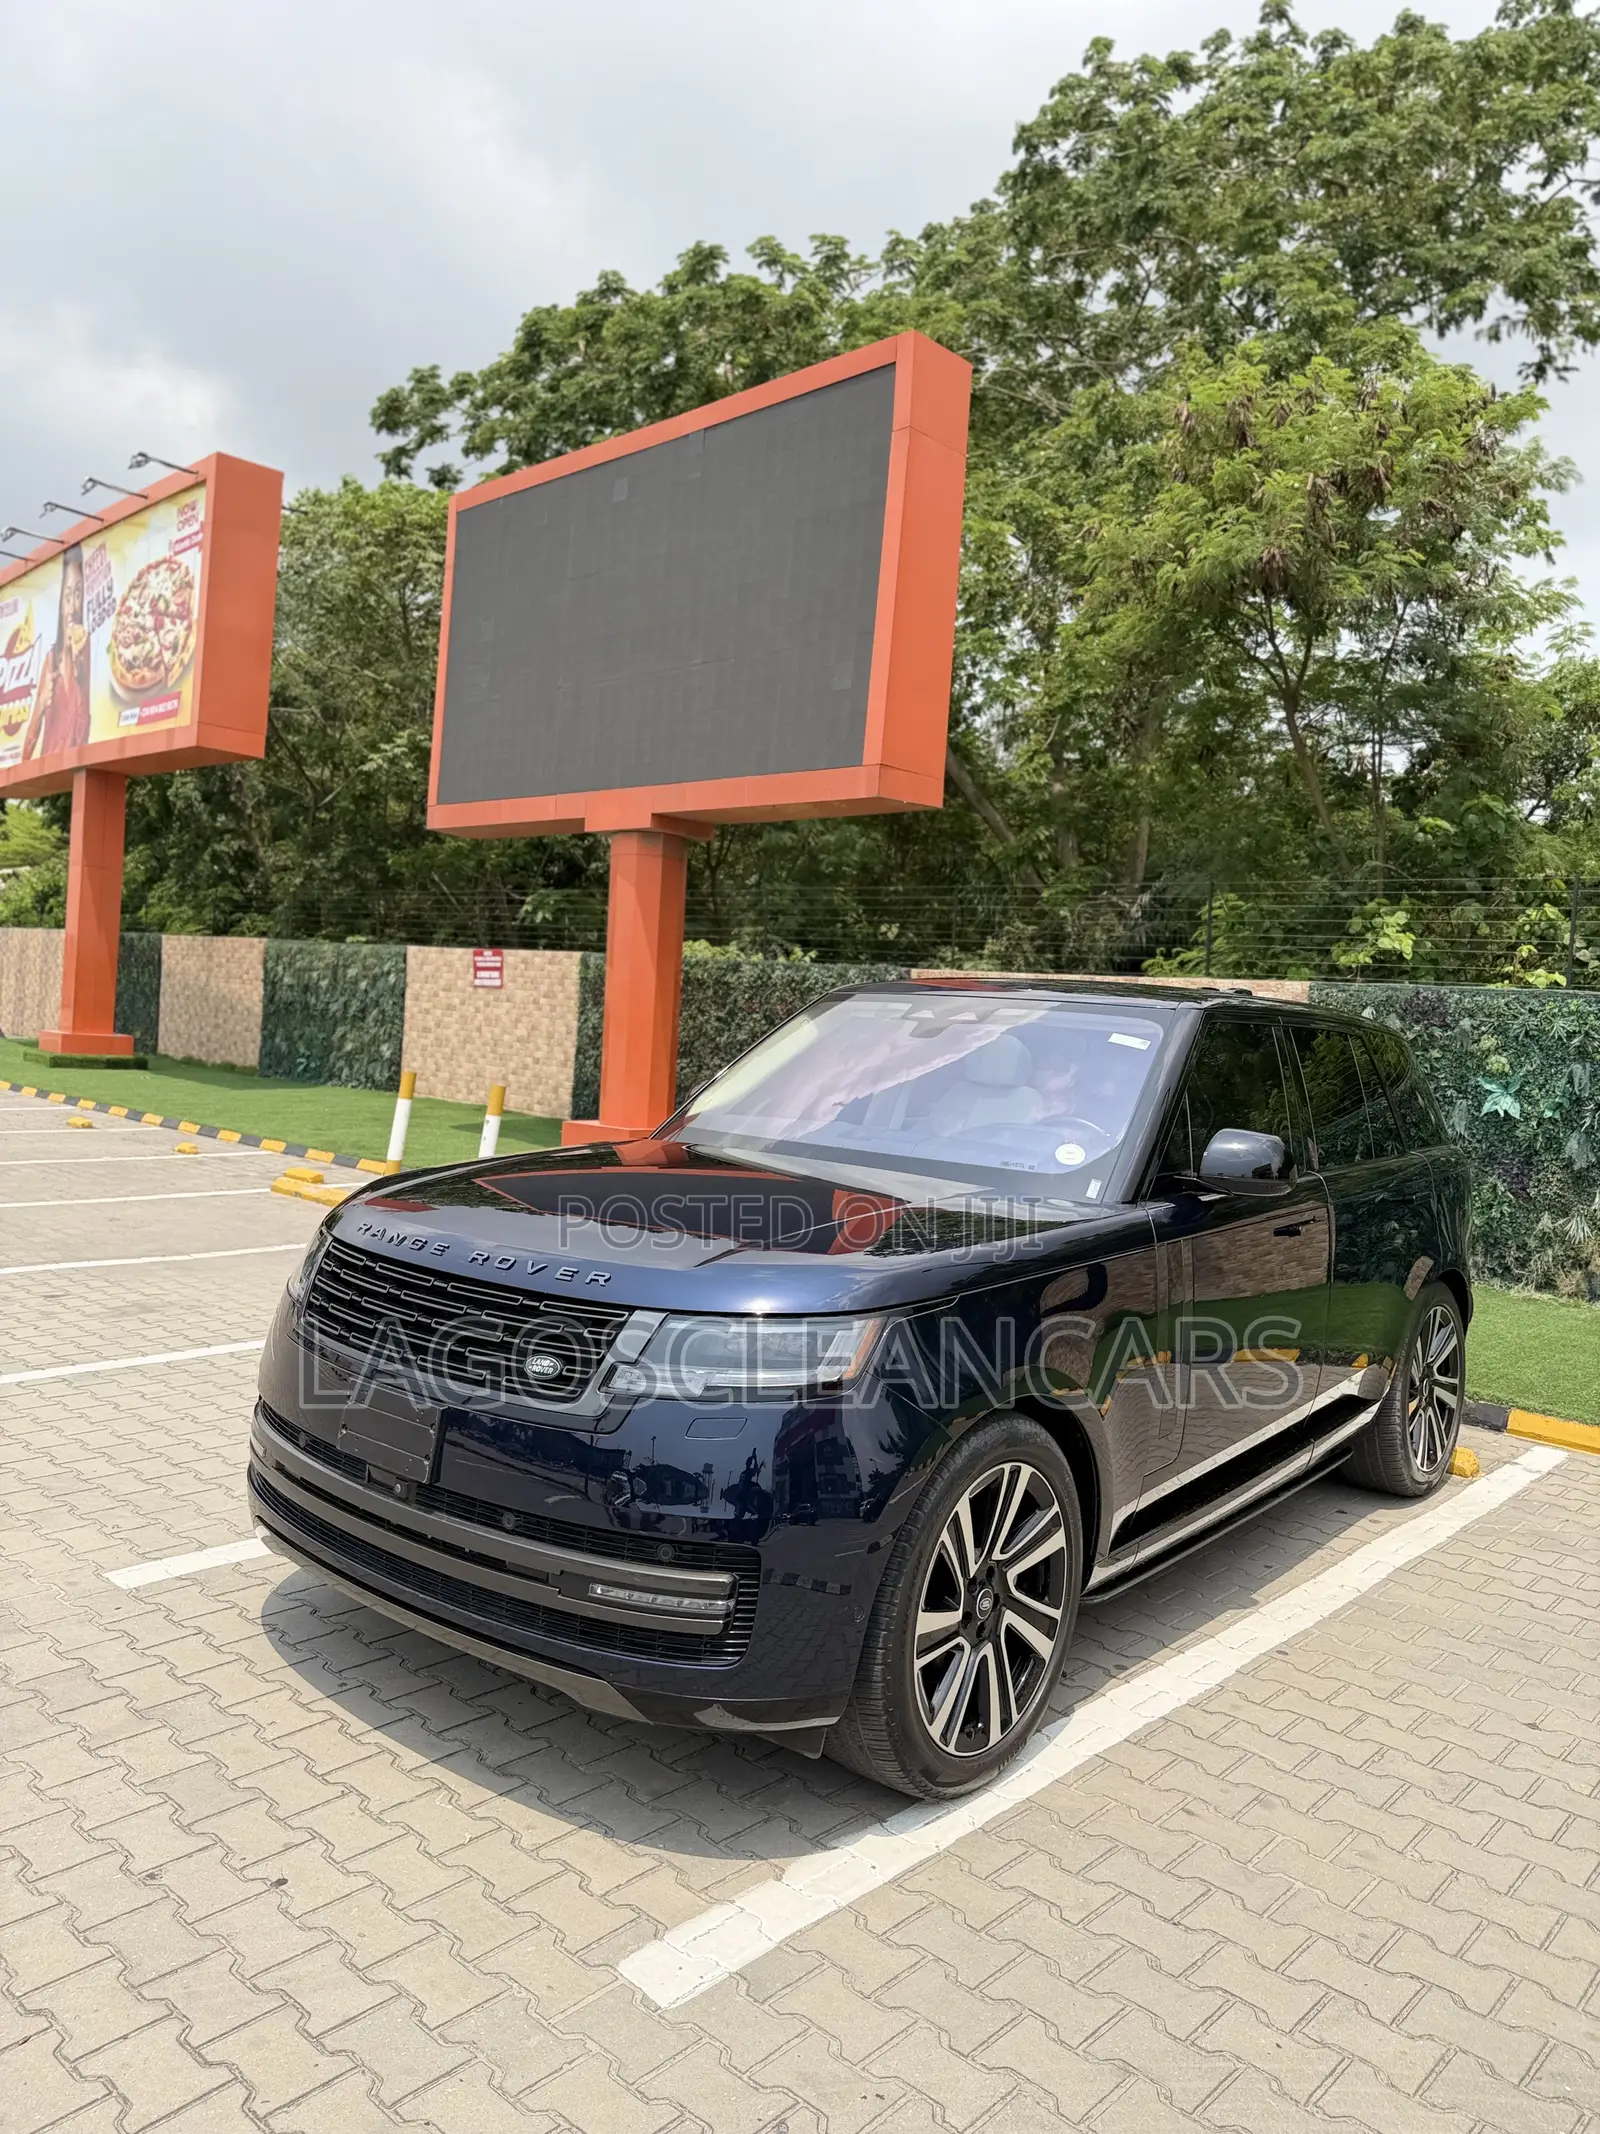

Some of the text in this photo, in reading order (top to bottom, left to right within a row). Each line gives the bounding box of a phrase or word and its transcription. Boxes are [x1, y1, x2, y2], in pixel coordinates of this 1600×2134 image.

[356, 1221, 612, 1287] RANGE ROVER
[532, 1358, 551, 1367] LAND
[532, 1365, 554, 1374] ROVER
